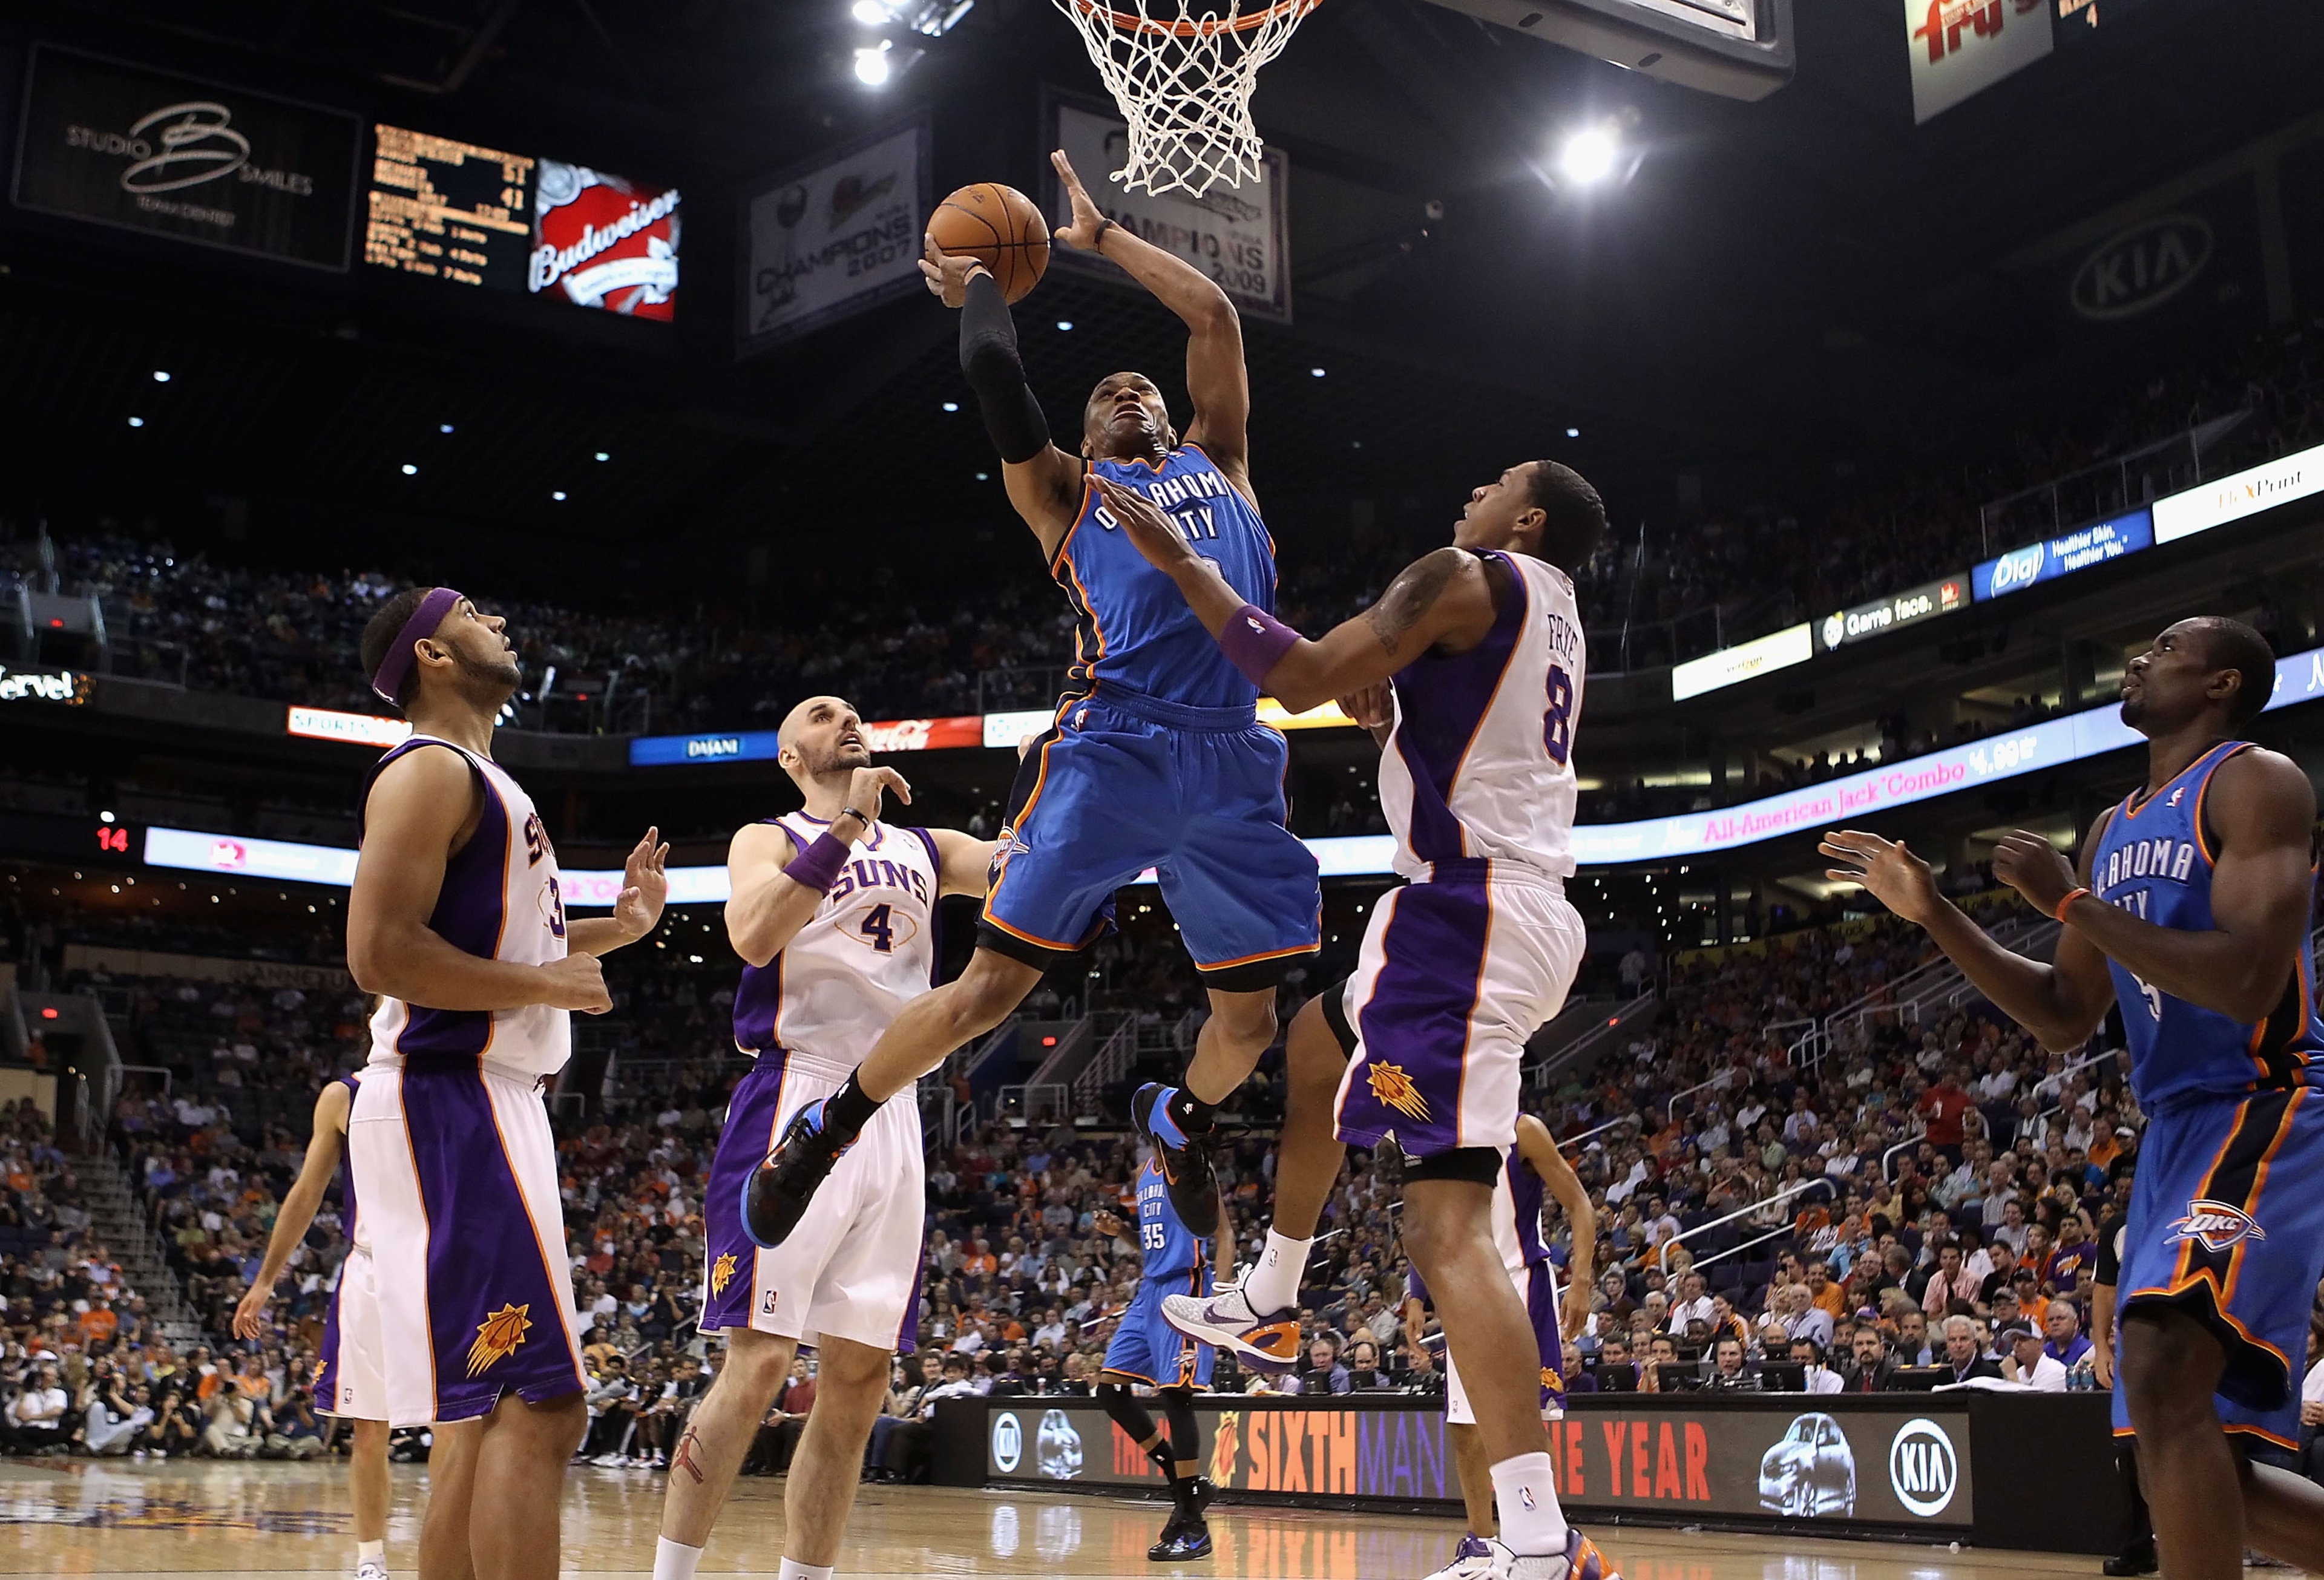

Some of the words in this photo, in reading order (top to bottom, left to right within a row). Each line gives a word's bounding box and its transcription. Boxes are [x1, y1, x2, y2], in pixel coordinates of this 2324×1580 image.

[66, 125, 152, 160] STUDIO
[239, 160, 313, 197] SMILES
[528, 189, 681, 293] Budweiser
[757, 212, 913, 297] CHAMPIONS
[847, 239, 913, 277] 2007
[1109, 208, 1265, 270] AMPIONS
[1212, 261, 1266, 293] 2009
[2095, 231, 2189, 303] KIA
[1095, 471, 1236, 529] OAHOM
[1170, 507, 1217, 540] ITY
[2052, 531, 2092, 559] Healthier
[2093, 523, 2116, 545] Skin.
[2064, 546, 2104, 572] Healthier
[1995, 551, 2040, 589] Dial
[1548, 614, 1578, 666] FRYE
[1846, 607, 1892, 636] Game
[1894, 595, 1933, 621] face.
[0, 664, 74, 701] erve!
[1727, 655, 1762, 673] verizon
[295, 715, 370, 736] SPORTS
[1542, 662, 1574, 768] 8
[1703, 797, 1833, 844] All-American
[1837, 781, 1880, 819] Jack
[97, 827, 128, 852] 14
[549, 875, 566, 940] 3
[830, 859, 929, 910] SUNS
[859, 902, 894, 953] 4
[1143, 1202, 1162, 1218] CITY
[2182, 1213, 2240, 1233] OKC
[1143, 1222, 1166, 1251] 35
[1247, 1411, 1356, 1495] SIXTH
[1357, 1411, 1445, 1498] MAN
[1542, 1421, 1585, 1496] HE
[1602, 1421, 1712, 1501] YEAR
[1901, 1442, 1947, 1493] KIA
